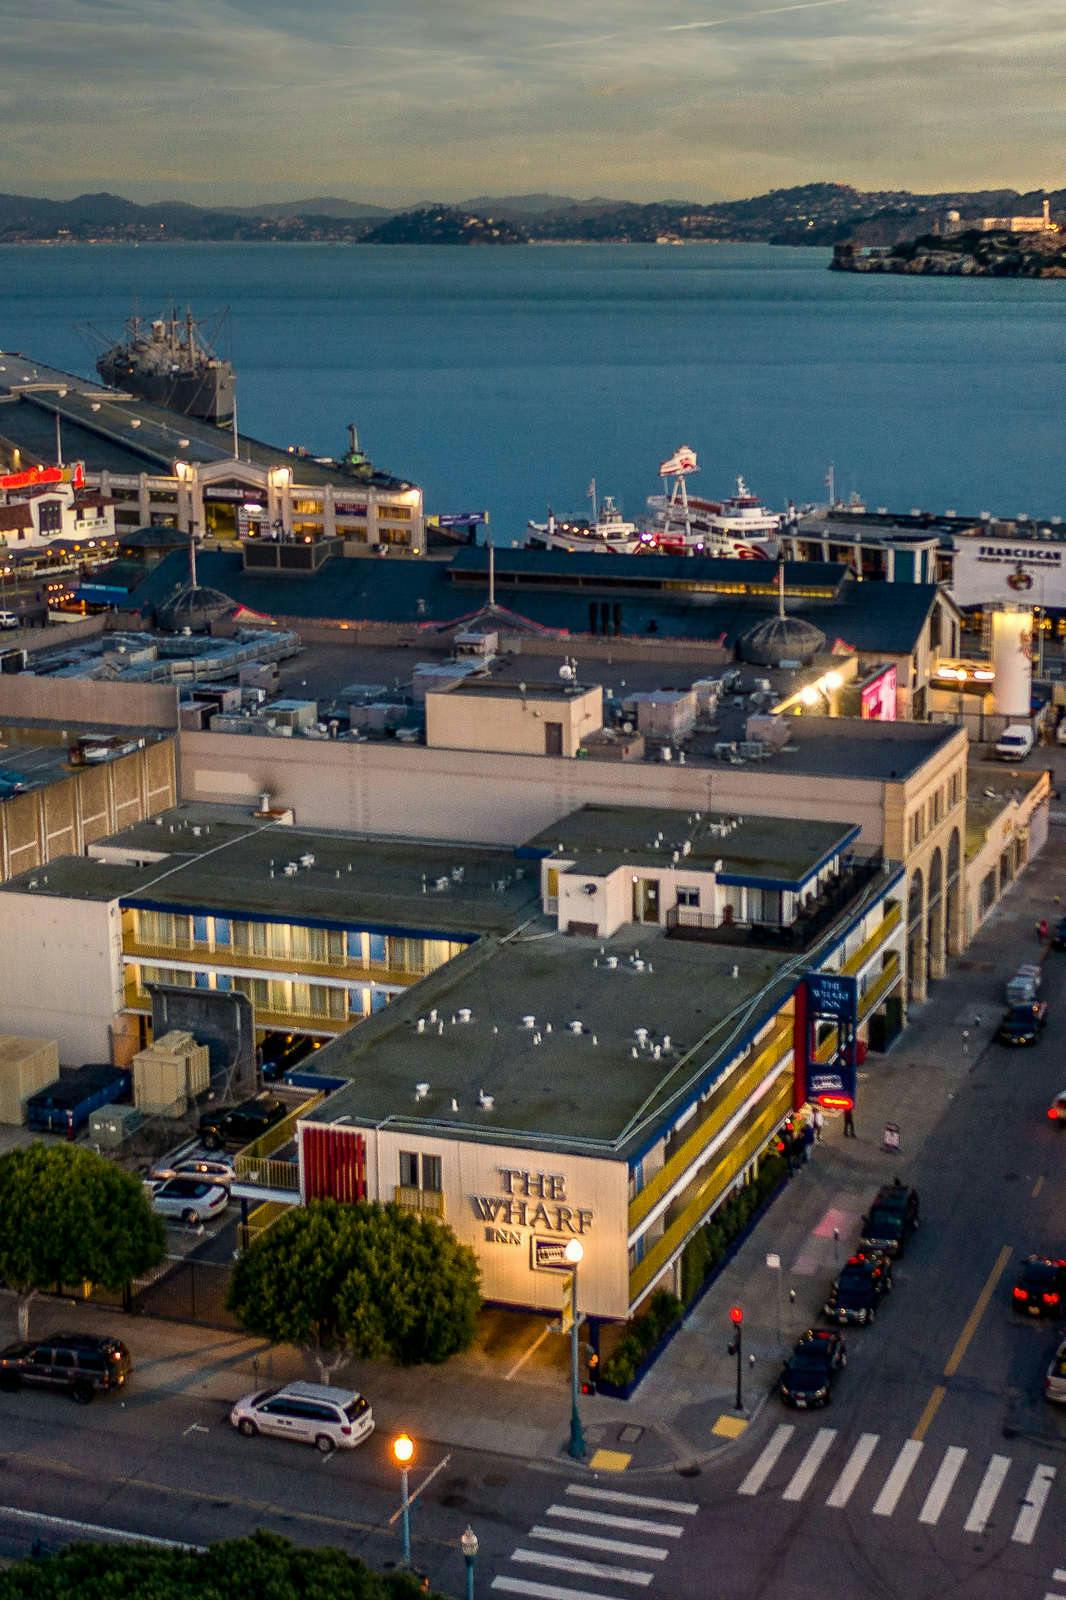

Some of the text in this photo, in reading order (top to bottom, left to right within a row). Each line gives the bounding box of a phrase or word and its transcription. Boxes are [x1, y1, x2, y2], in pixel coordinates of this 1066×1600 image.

[979, 546, 1062, 561] FRANCISCAN
[497, 1167, 567, 1201] THE
[467, 1194, 594, 1234] WHARF
[485, 1226, 522, 1245] INN
